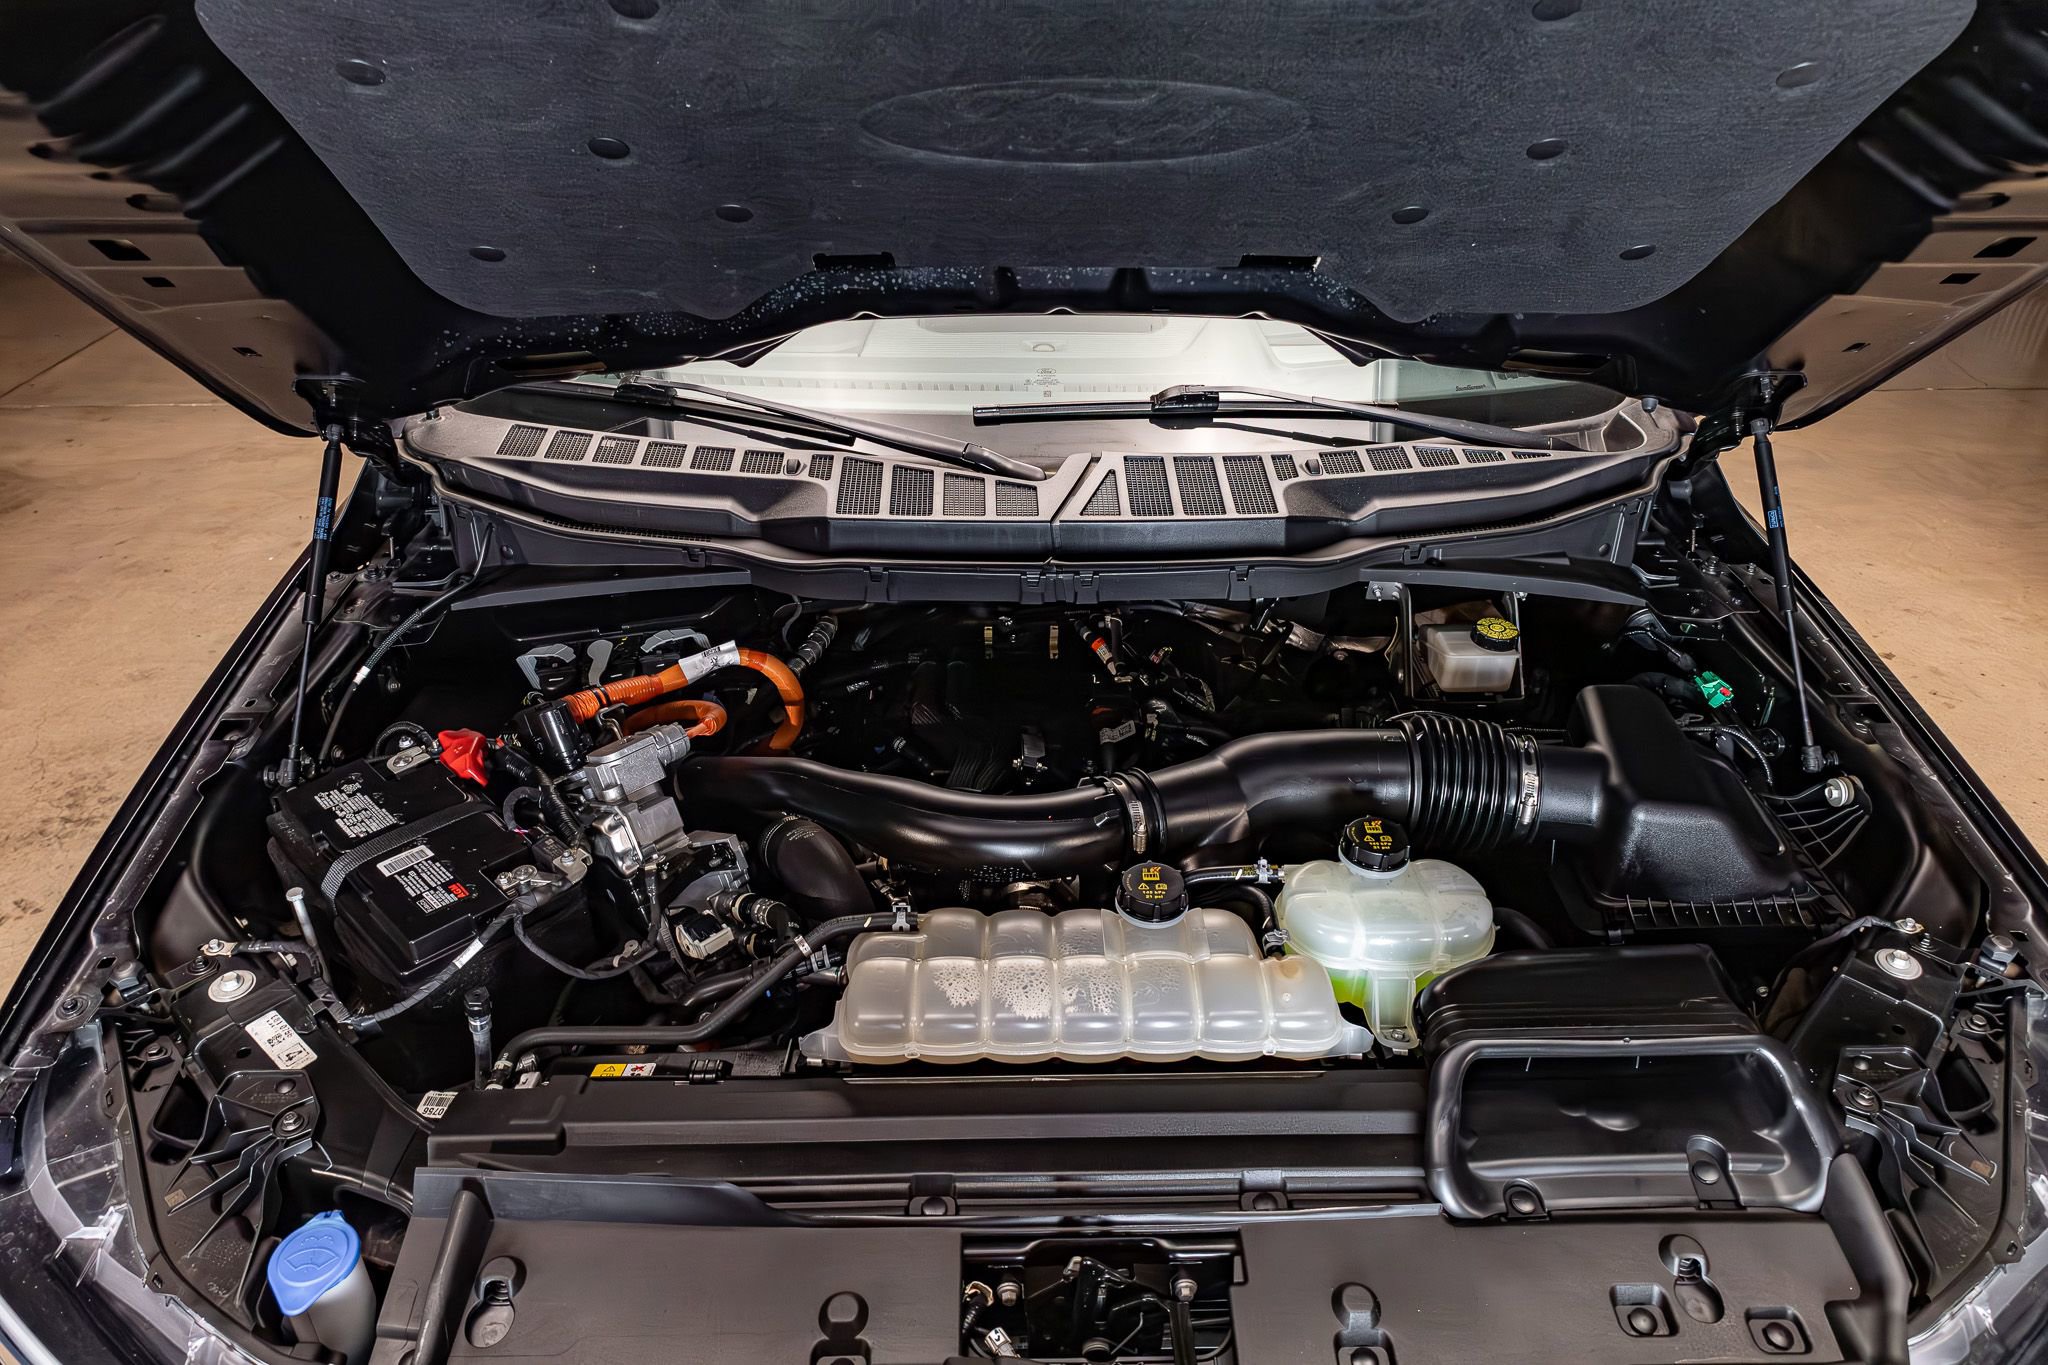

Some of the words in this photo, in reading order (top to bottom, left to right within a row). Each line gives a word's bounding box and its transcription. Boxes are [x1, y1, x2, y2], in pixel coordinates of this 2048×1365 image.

[448, 883, 467, 898] AGM
[285, 1050, 303, 1063] 4
[422, 1106, 445, 1116] 0756
